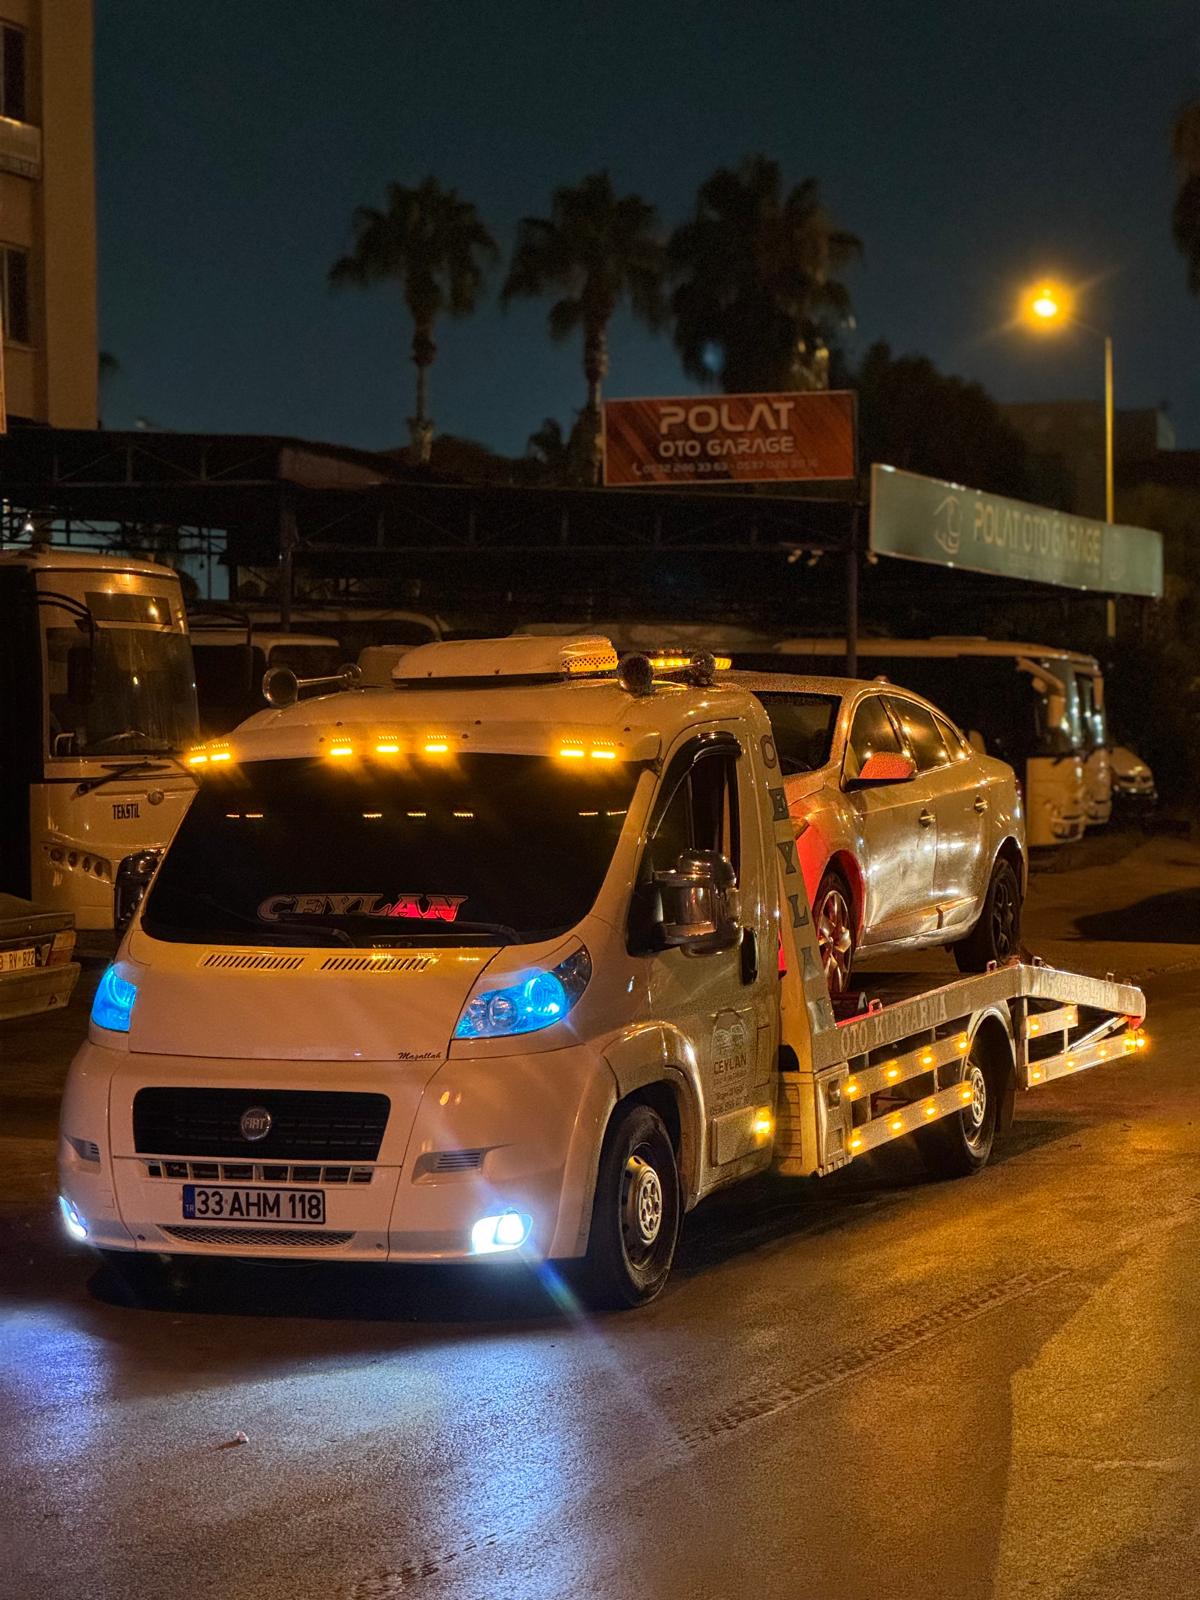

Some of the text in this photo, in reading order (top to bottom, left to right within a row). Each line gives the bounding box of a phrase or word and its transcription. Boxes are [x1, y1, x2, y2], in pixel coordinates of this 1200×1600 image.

[660, 401, 795, 435] POLAT
[659, 436, 795, 457] OTO GARAGE
[974, 501, 1020, 549] POLAT
[1023, 514, 1049, 555] OTO
[257, 893, 469, 922] CEYLAN
[841, 1022, 868, 1058] OTO
[714, 1053, 747, 1075] CEYLAN
[244, 1117, 266, 1130] FIAT
[185, 1190, 322, 1220] TR 33 AHM 118
